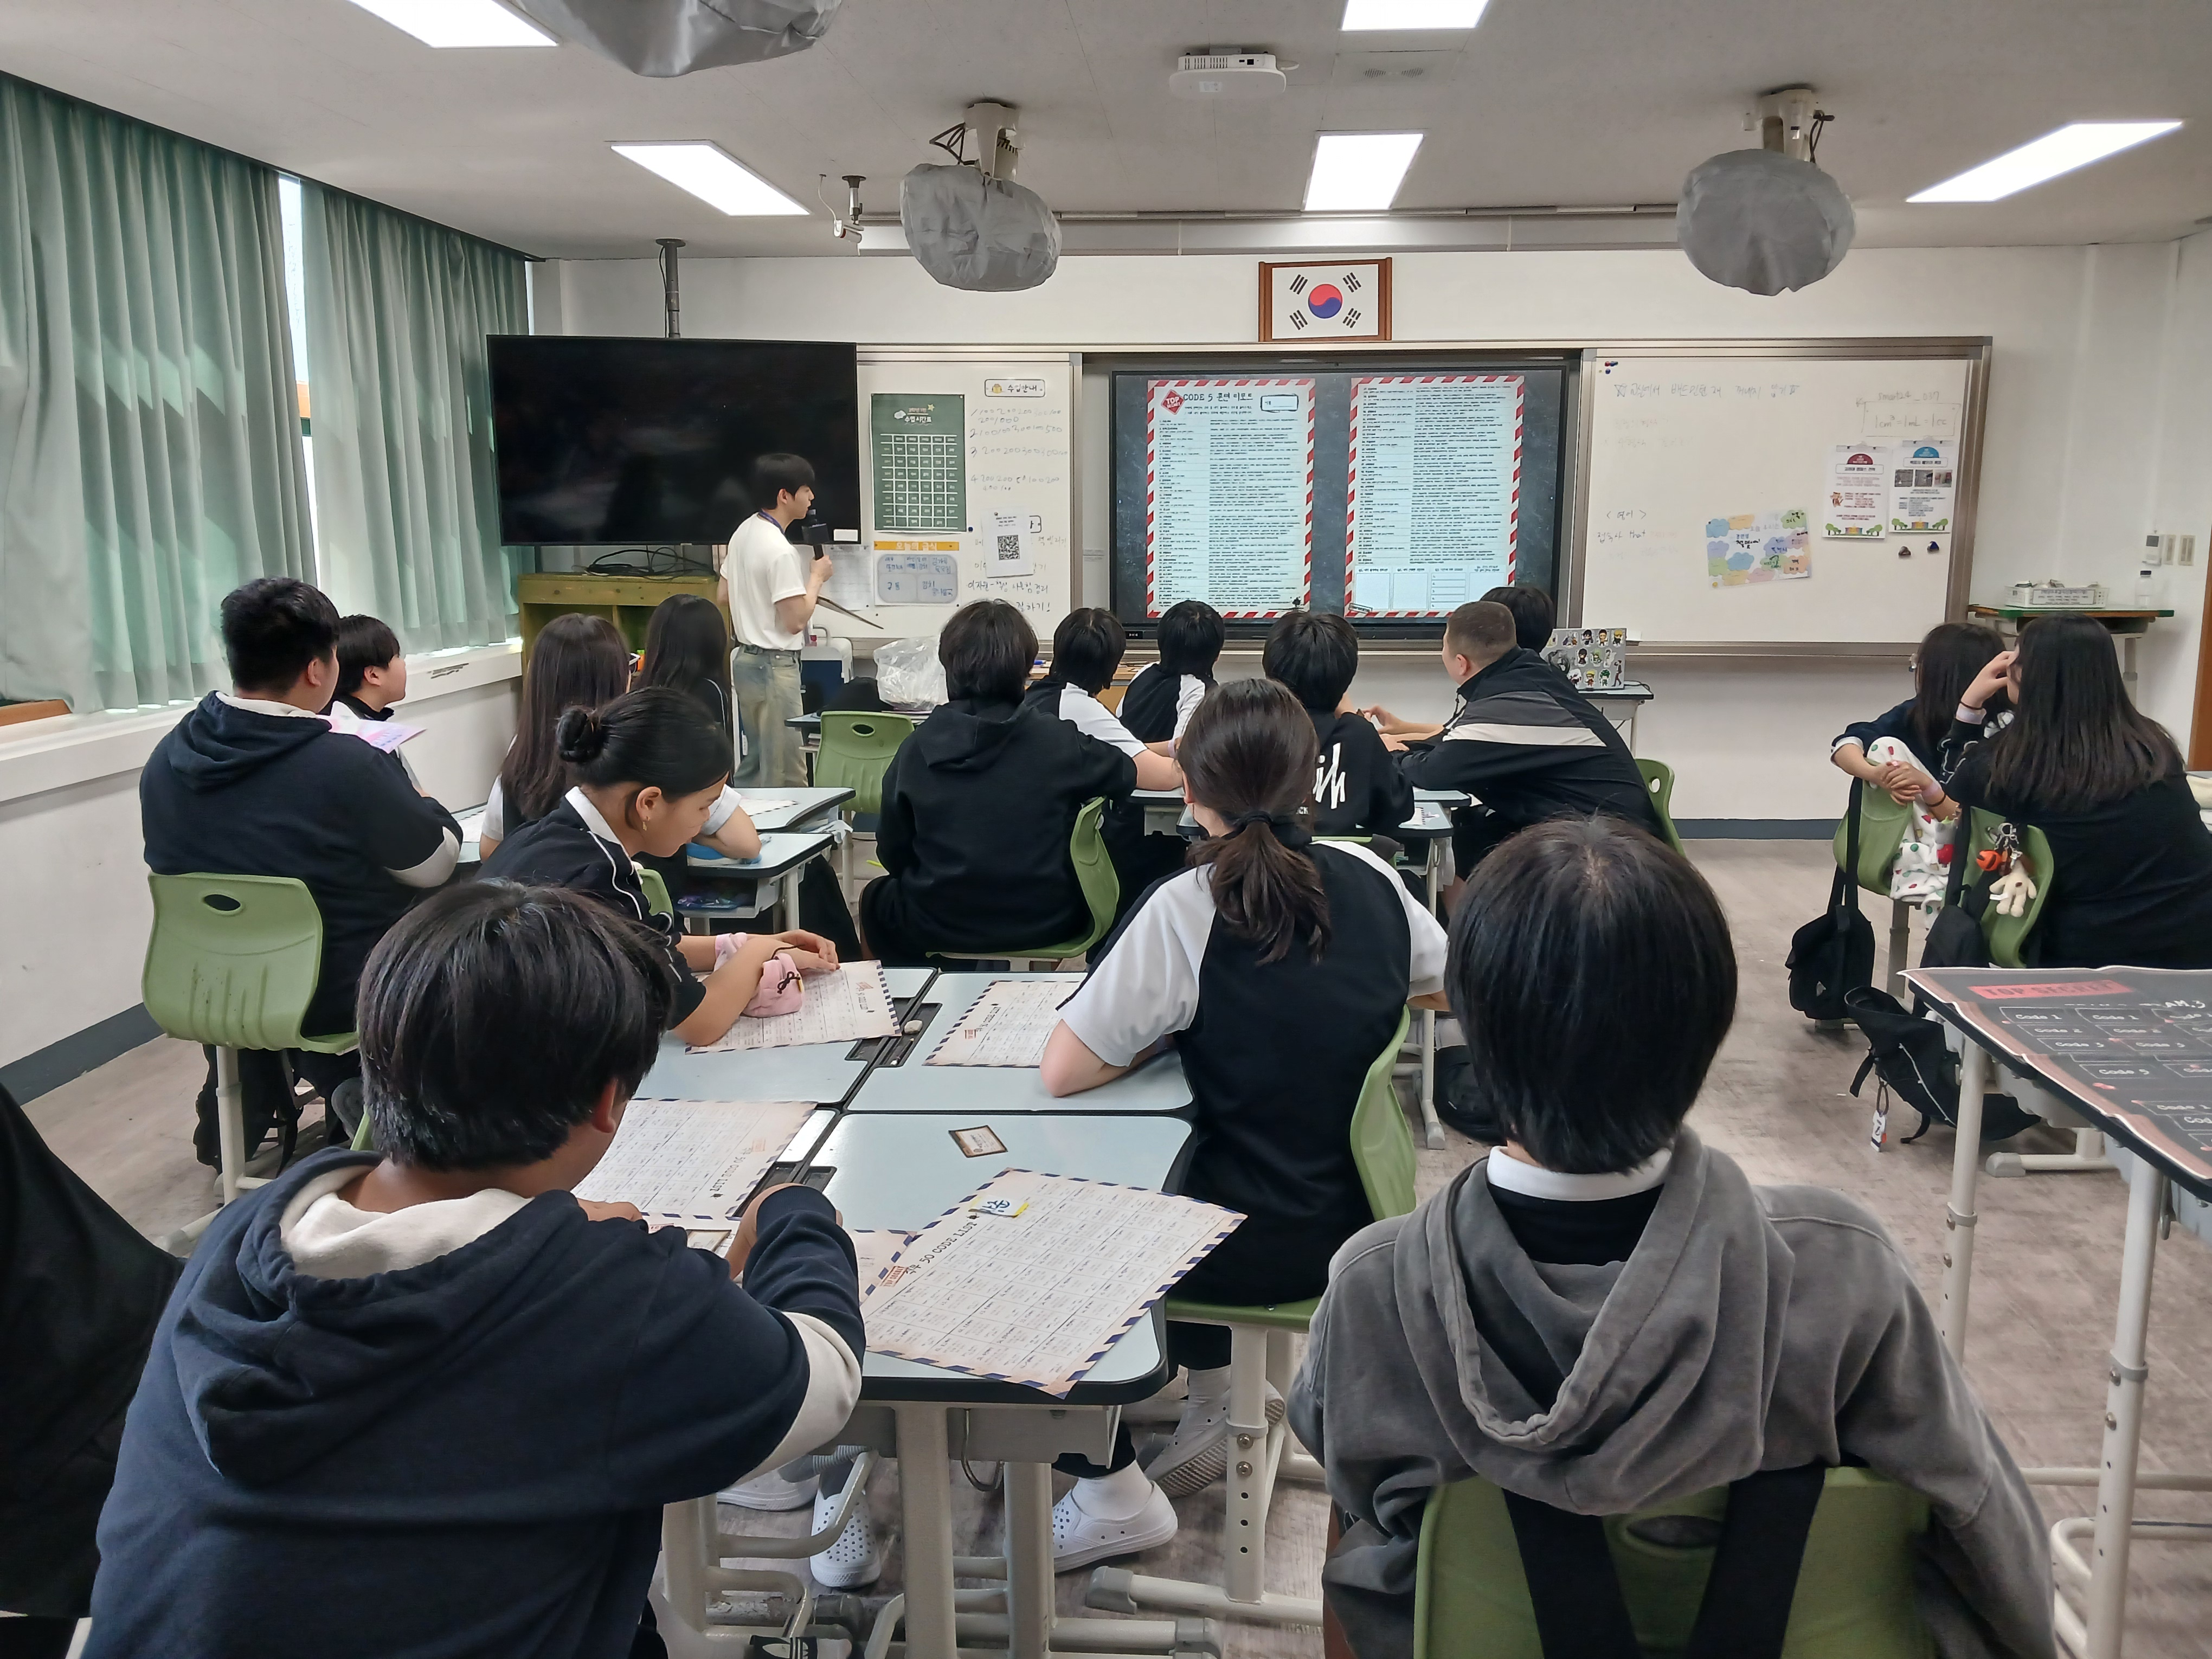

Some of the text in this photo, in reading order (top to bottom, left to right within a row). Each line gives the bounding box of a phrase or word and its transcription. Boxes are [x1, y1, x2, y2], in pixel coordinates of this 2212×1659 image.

[1207, 394, 1213, 402] 5
[1233, 393, 1253, 402] 리포트
[1630, 529, 1646, 538] that
[1983, 983, 2114, 996] TOP SECRET
[919, 1253, 935, 1264] 50
[931, 1237, 957, 1253] CODE
[953, 1221, 978, 1237] LIST
